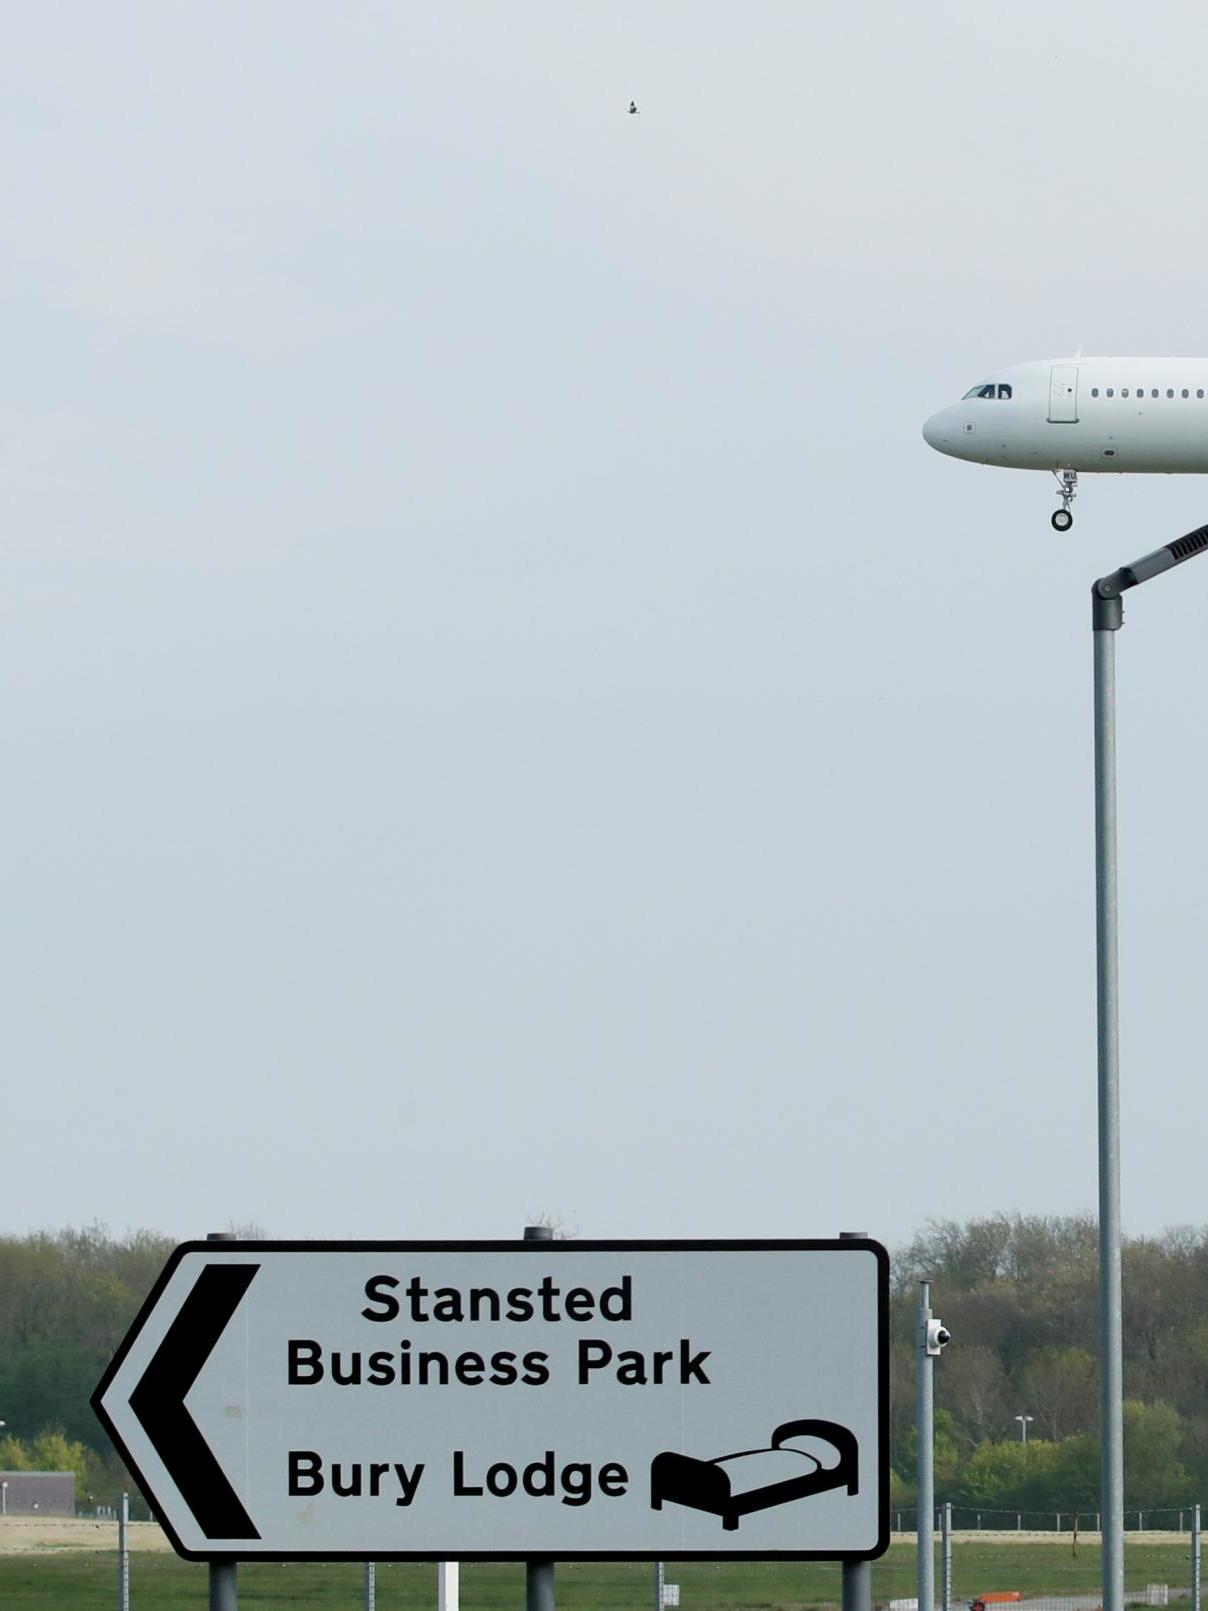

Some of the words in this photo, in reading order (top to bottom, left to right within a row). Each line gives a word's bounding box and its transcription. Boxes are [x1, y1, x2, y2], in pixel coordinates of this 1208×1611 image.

[361, 1275, 633, 1323] Stansted
[288, 1340, 550, 1386] Business
[579, 1339, 712, 1386] Park
[288, 1451, 426, 1507] Bury
[453, 1451, 629, 1507] Lodge
